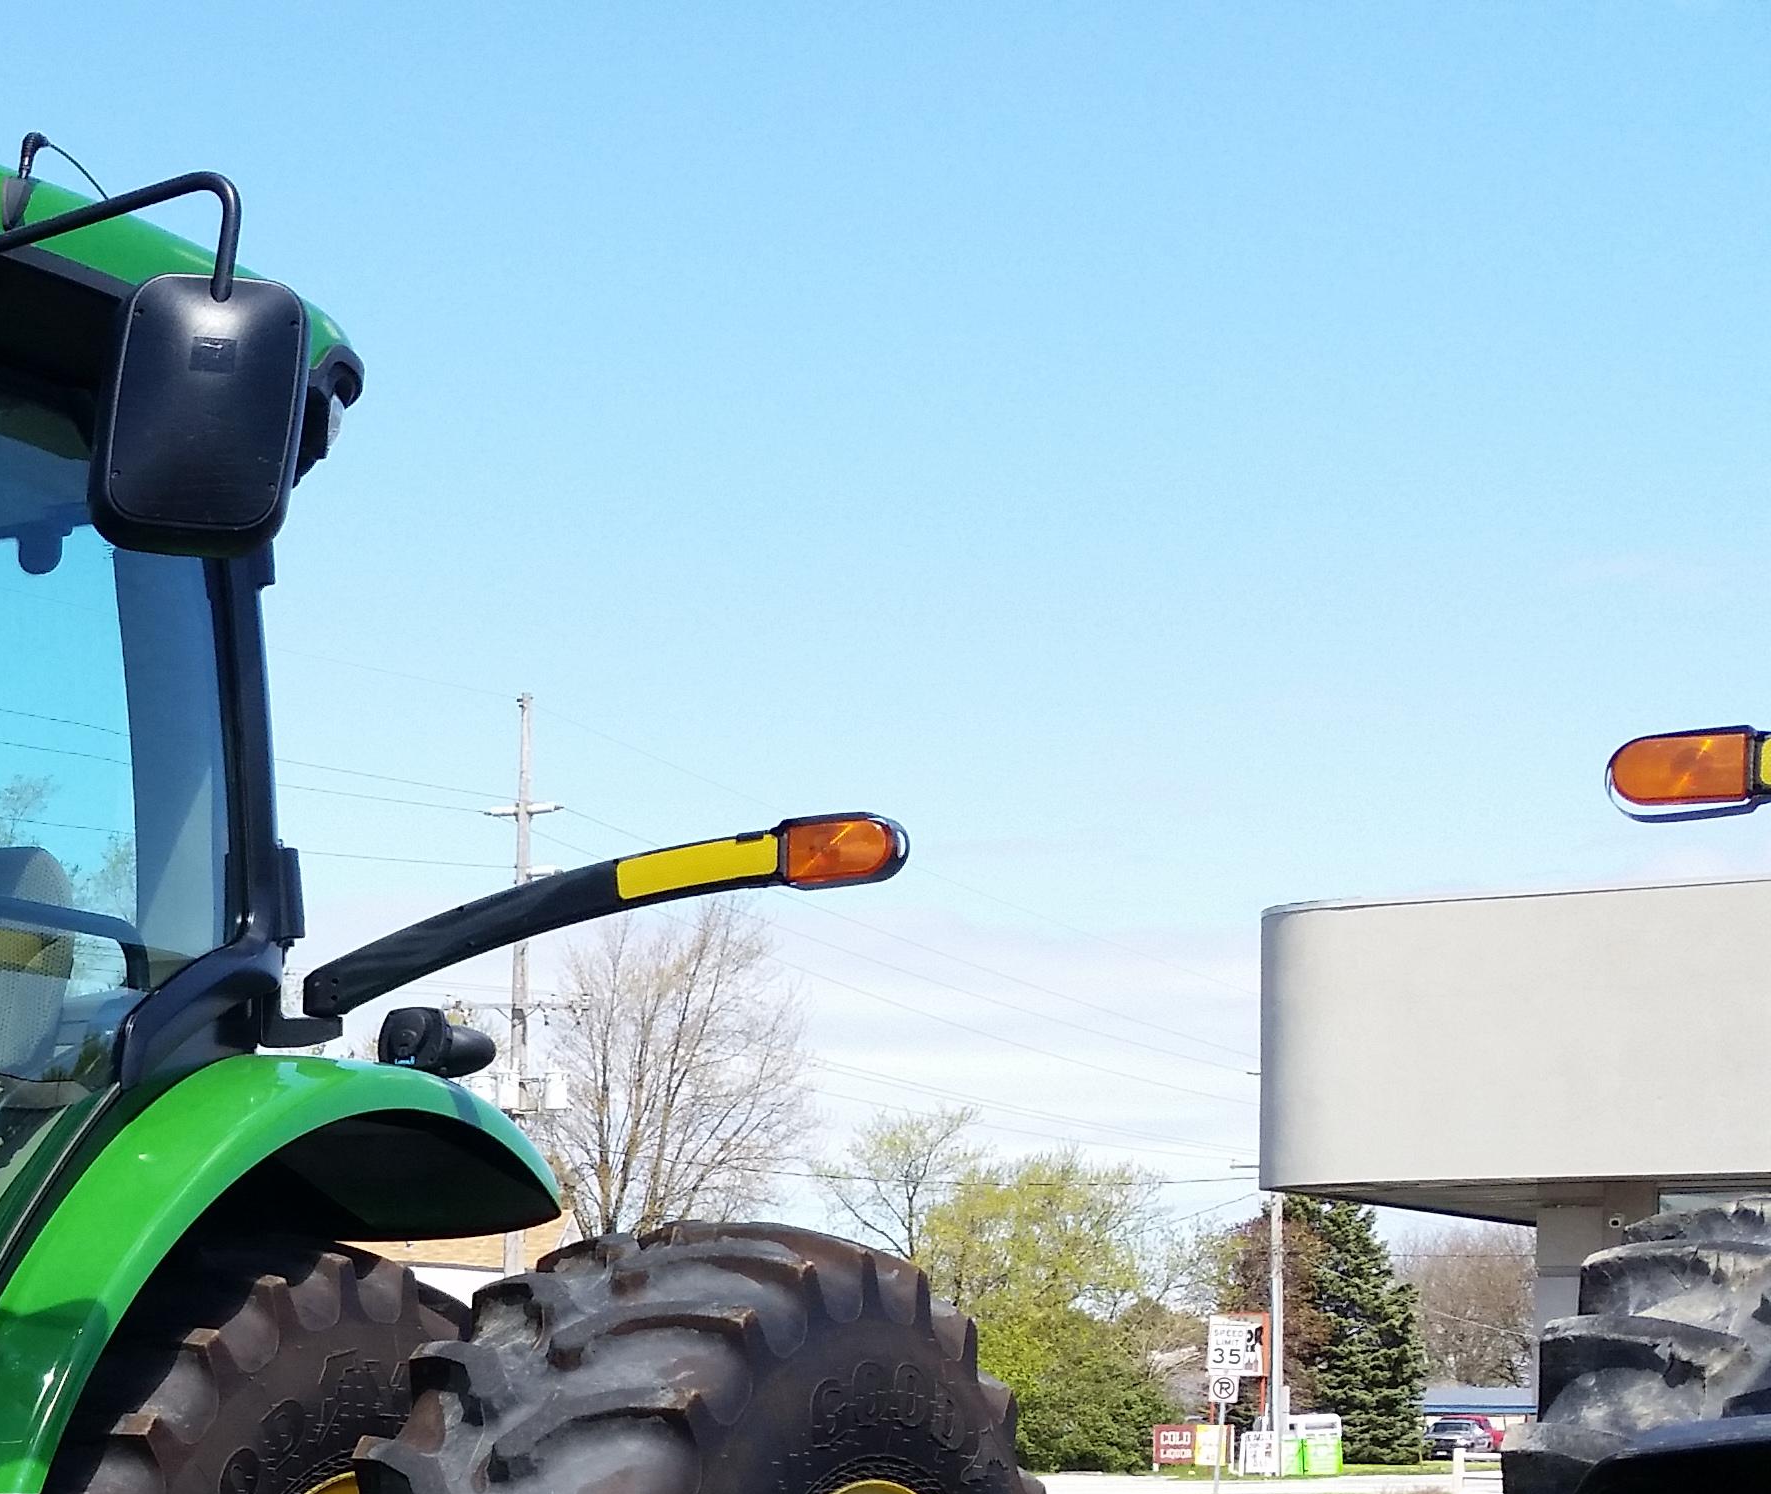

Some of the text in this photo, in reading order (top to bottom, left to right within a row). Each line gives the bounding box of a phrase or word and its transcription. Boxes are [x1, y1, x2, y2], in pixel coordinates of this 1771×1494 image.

[1214, 1329, 1244, 1338] SPEED
[1212, 1347, 1241, 1365] 35
[1160, 1431, 1191, 1446] COLD
[1160, 1448, 1192, 1460] LIQUOR
